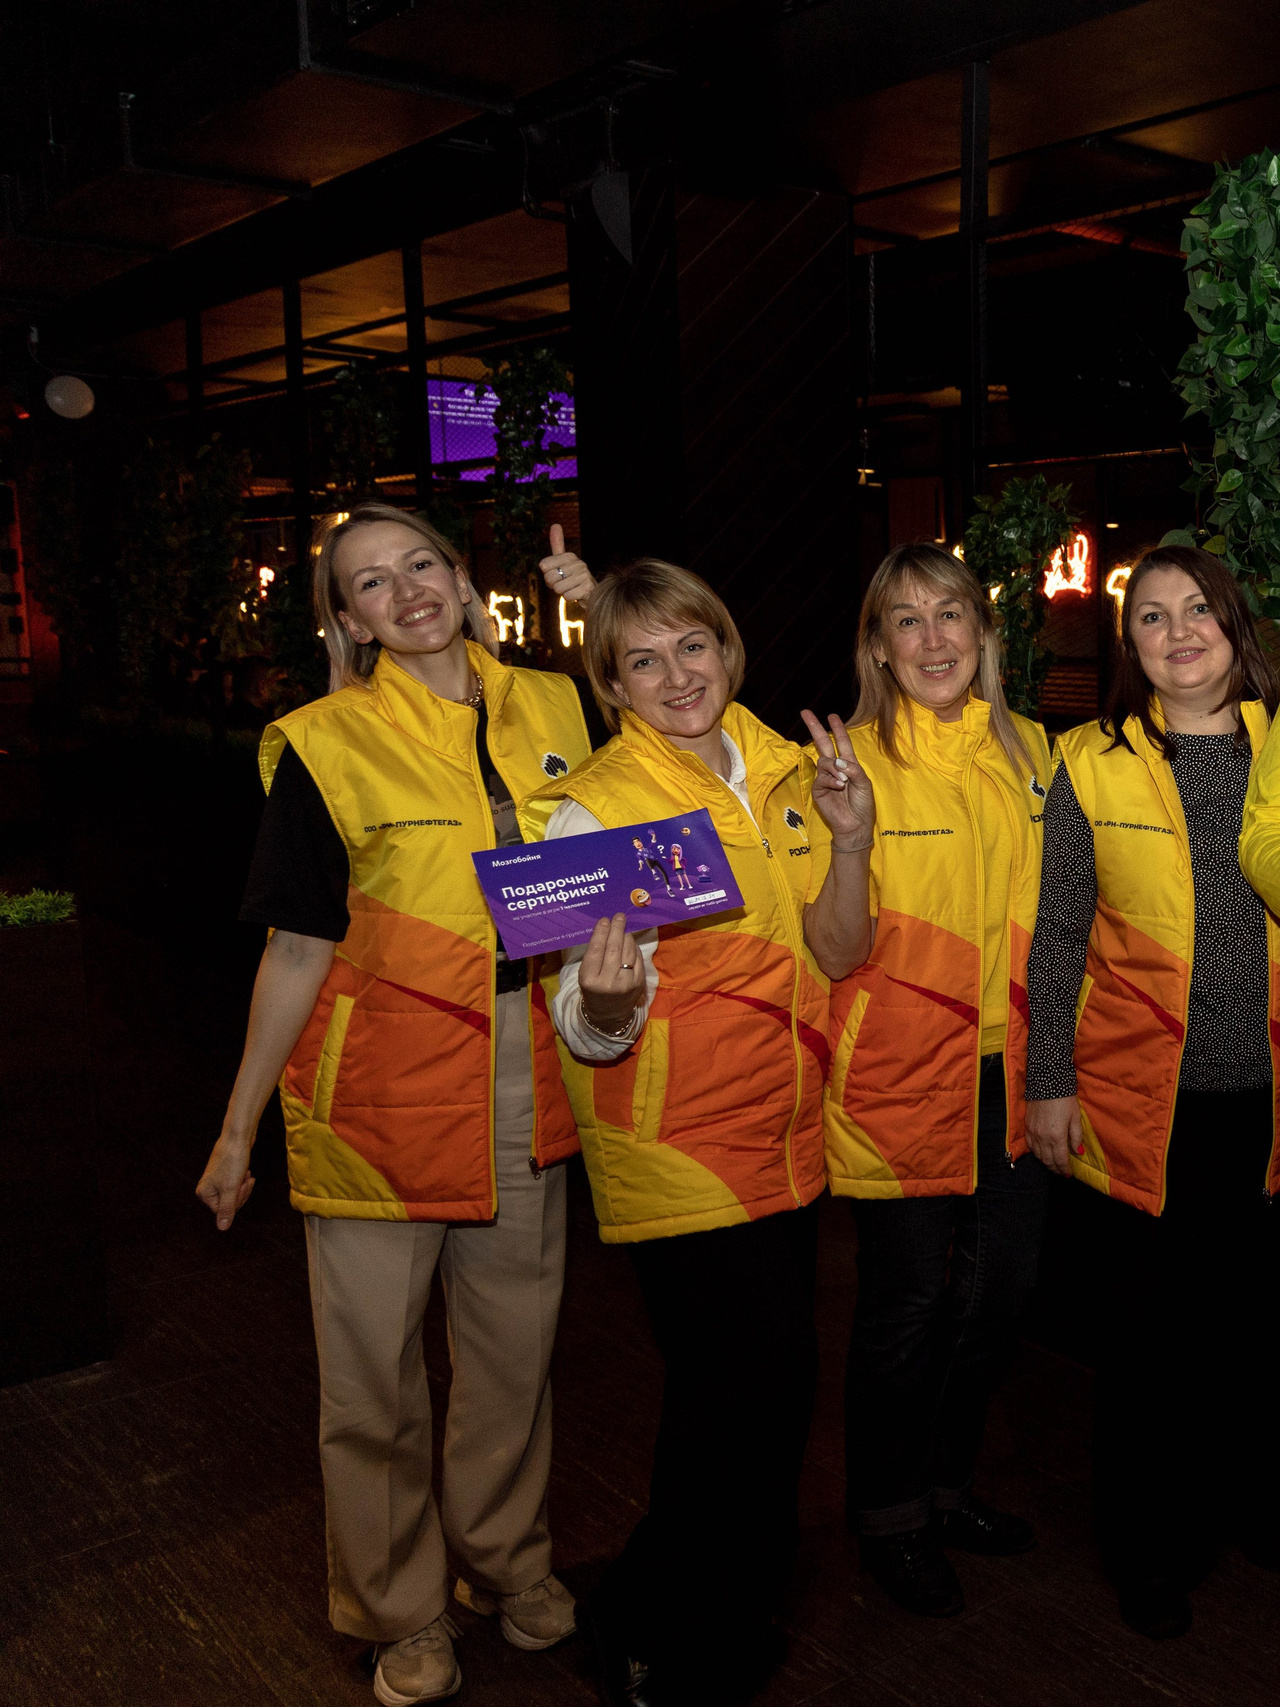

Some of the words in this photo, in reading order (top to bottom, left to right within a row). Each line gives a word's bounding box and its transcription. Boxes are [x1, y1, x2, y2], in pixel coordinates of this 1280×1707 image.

[881, 829, 954, 837] «РН-ПУРНЕФТЕГАЗ»
[1103, 821, 1175, 835] «РН-ПУРНЕФТЕГАЗ»
[788, 845, 811, 857] РОСН
[492, 854, 541, 867] Мозгобойня
[501, 867, 609, 899] Подарочный
[507, 883, 606, 911] сертификат
